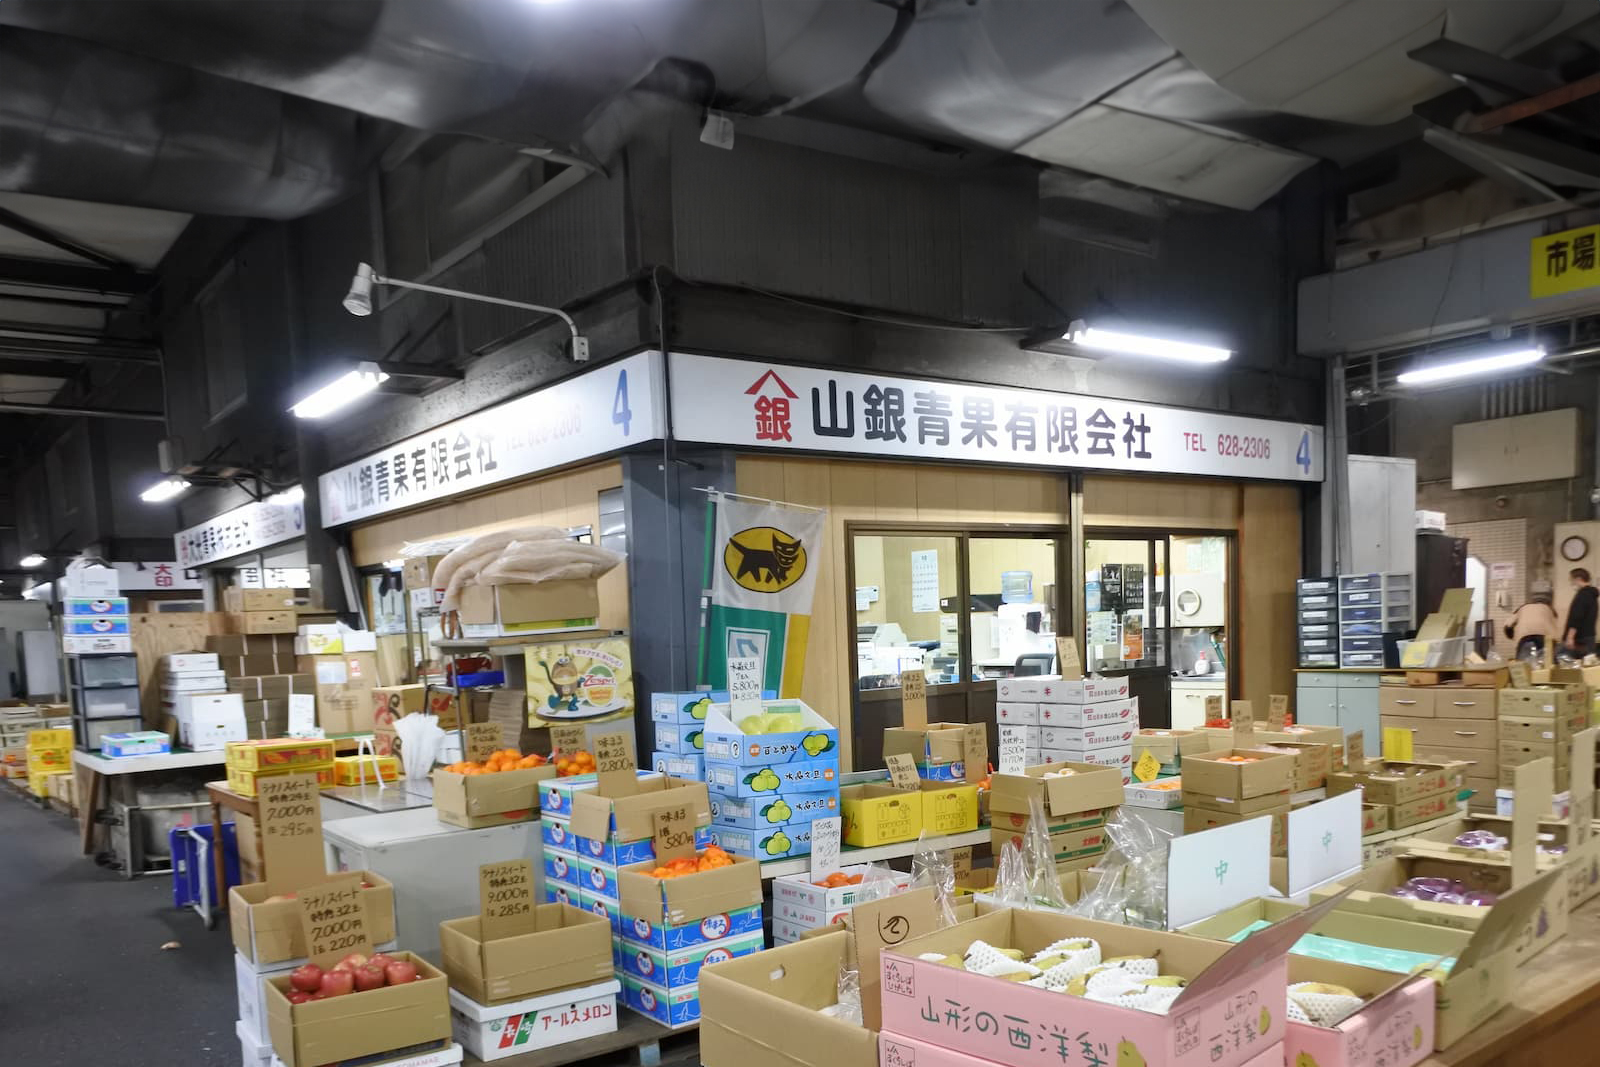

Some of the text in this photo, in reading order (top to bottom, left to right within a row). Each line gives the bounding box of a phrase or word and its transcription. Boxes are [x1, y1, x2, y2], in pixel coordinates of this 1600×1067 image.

[1546, 231, 1600, 278] 市場
[612, 368, 632, 437] 4
[754, 397, 792, 442] 銀
[811, 377, 1271, 461] 山銀青果有限会社 TEL 628-2306
[345, 429, 498, 514] 山銀青果有限会社
[1296, 430, 1311, 474] 4
[541, 1003, 612, 1032] アールスメロン
[920, 995, 1109, 1067] 山形の西洋梨
